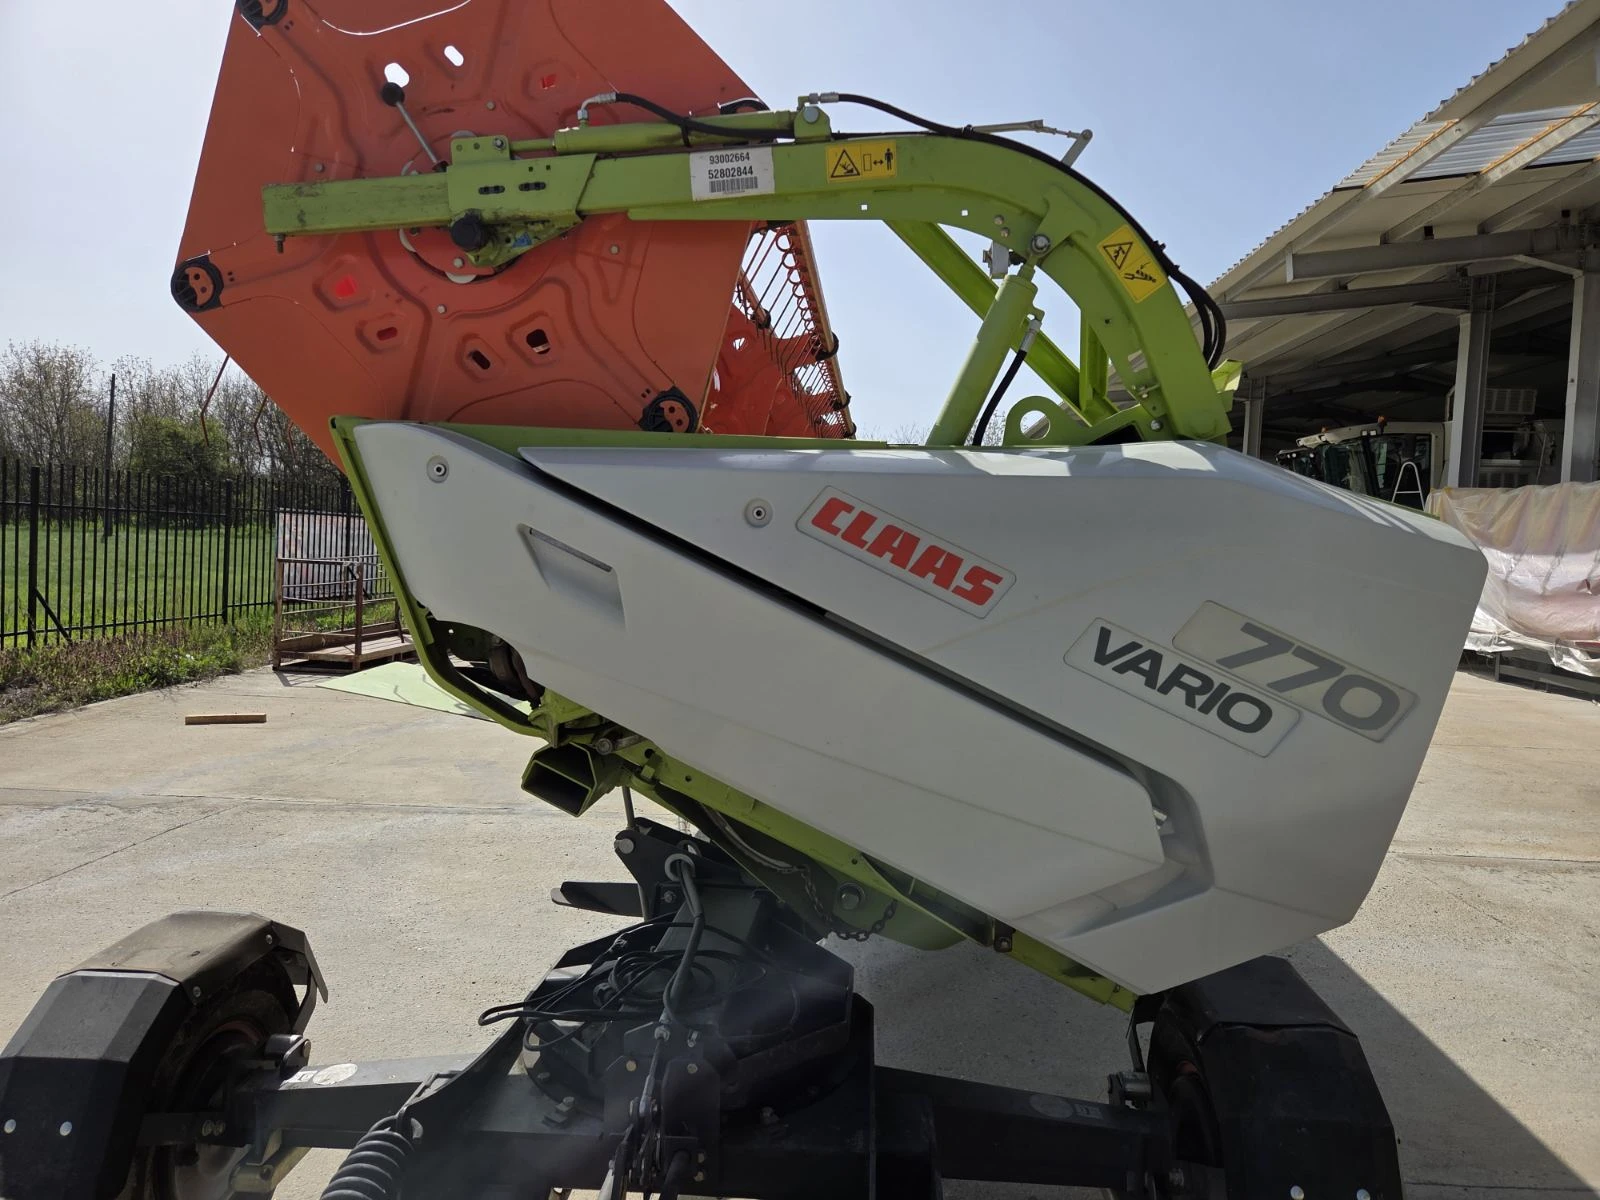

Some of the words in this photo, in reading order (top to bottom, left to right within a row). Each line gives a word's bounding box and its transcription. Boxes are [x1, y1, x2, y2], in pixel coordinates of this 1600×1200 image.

[708, 165, 753, 179] 52802844
[709, 152, 750, 165] 93002664
[811, 497, 1003, 606] CLAAS
[1093, 626, 1273, 734] VARIO
[1216, 622, 1400, 731] 770
